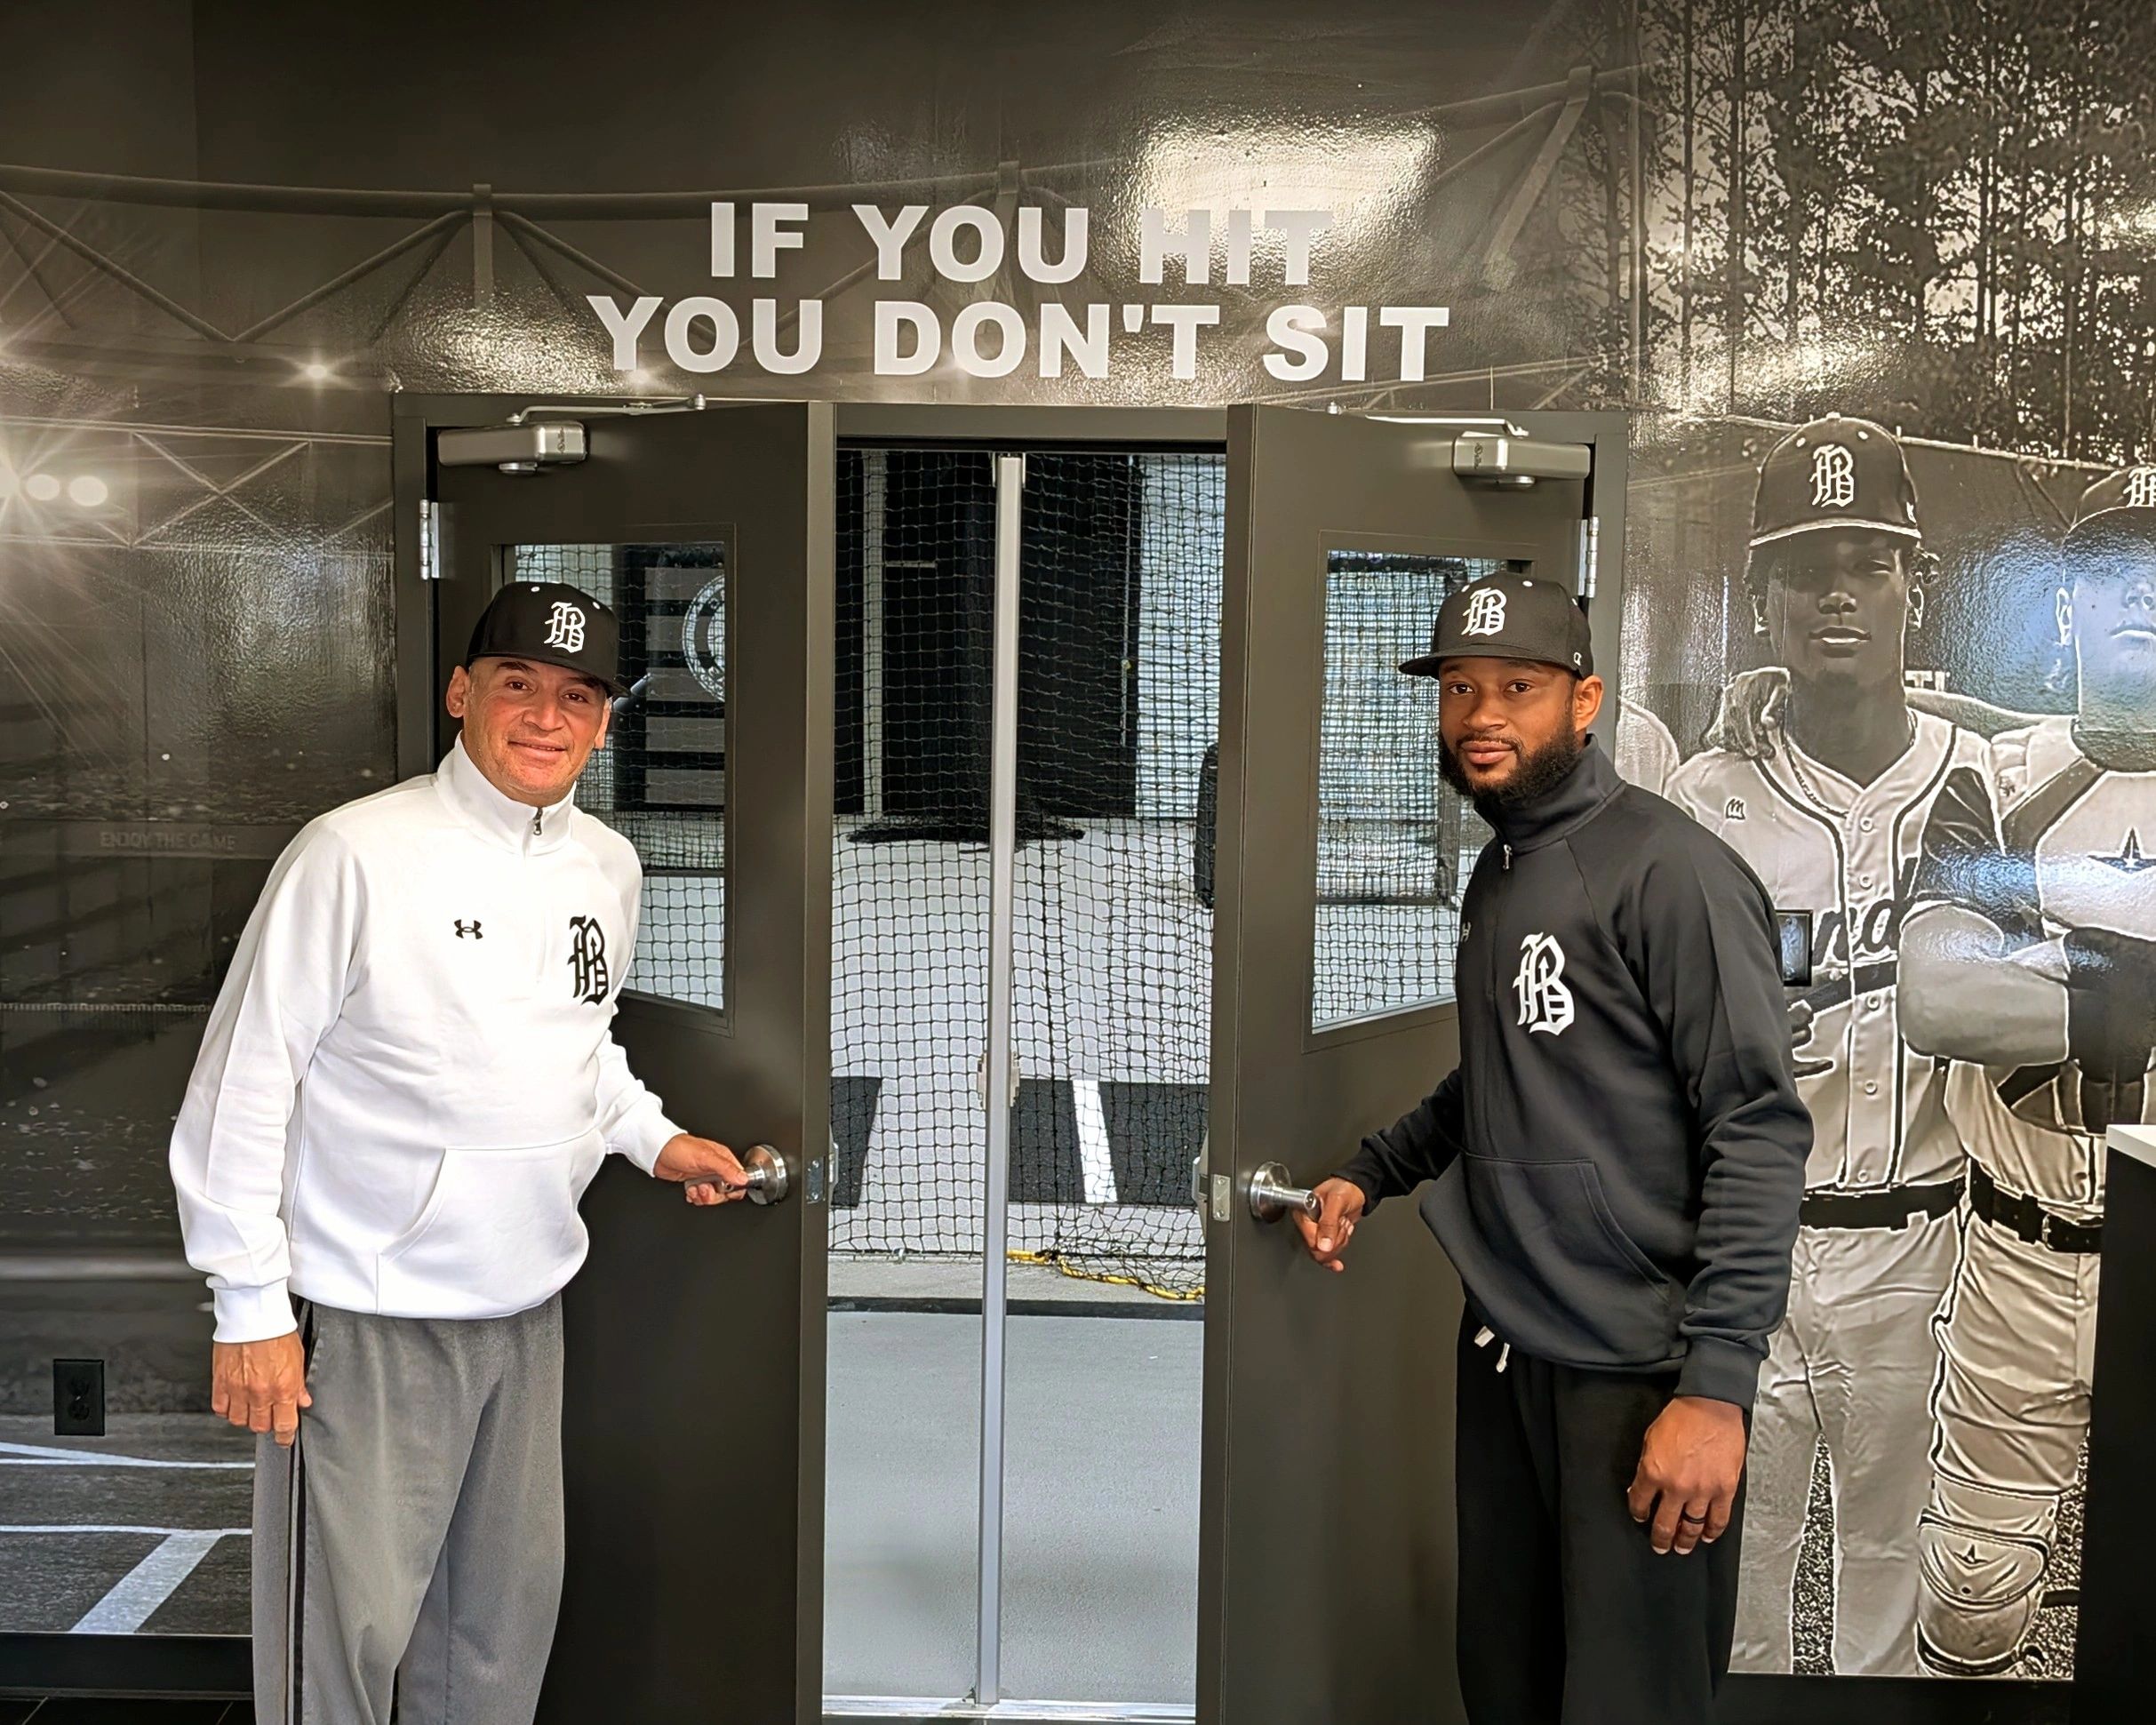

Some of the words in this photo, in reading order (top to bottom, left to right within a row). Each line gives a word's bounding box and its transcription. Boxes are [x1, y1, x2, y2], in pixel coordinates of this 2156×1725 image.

[711, 202, 809, 278] IF
[850, 204, 1089, 284] YOU
[1138, 208, 1333, 286] HIT
[587, 295, 823, 375] YOU
[873, 300, 1220, 379] DON'T
[1263, 306, 1450, 382] SIT
[154, 832, 186, 849] THE
[189, 832, 237, 851] GAME
